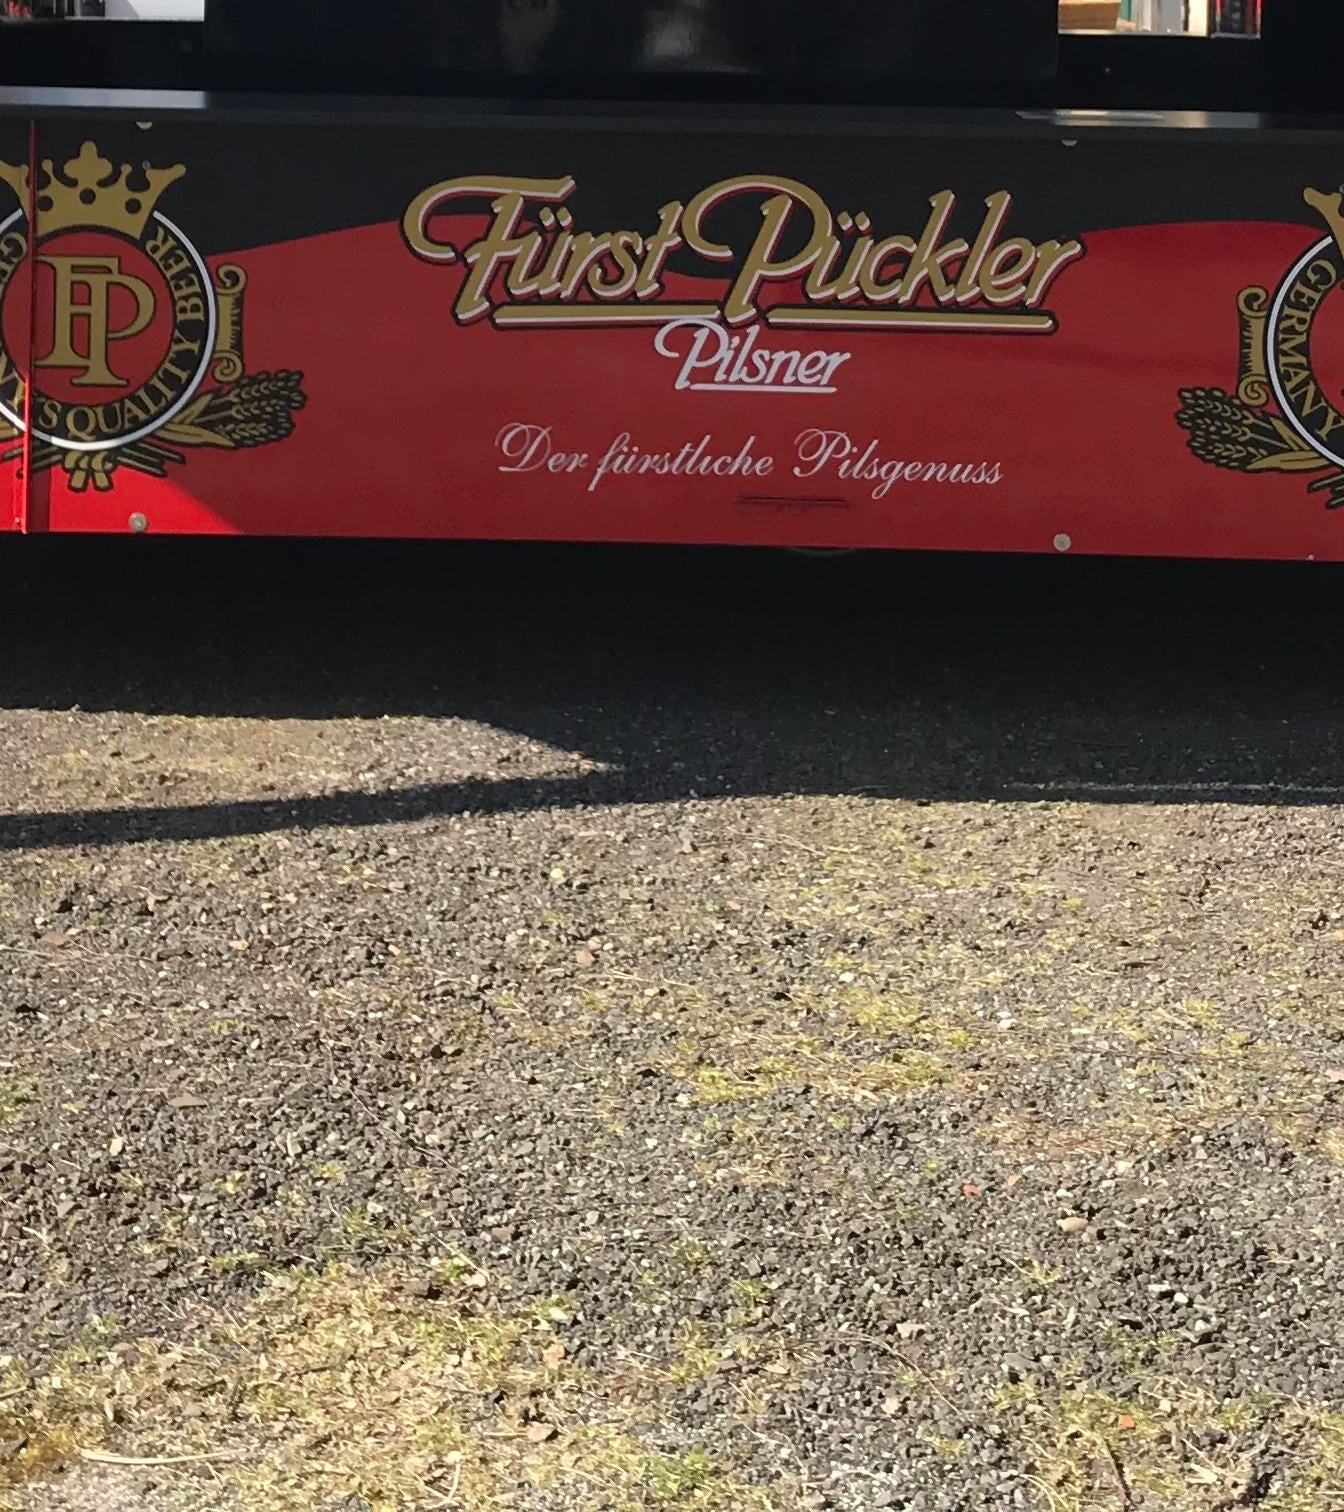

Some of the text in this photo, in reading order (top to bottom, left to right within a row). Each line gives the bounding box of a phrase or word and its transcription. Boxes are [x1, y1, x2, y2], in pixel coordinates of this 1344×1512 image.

[402, 174, 1085, 326] Fürst Pückler
[66, 331, 201, 441] QUALITY
[145, 226, 205, 323] BEER
[654, 318, 851, 390] Pilsner
[494, 422, 1004, 500] Der fürstliche Pilsgenuss
